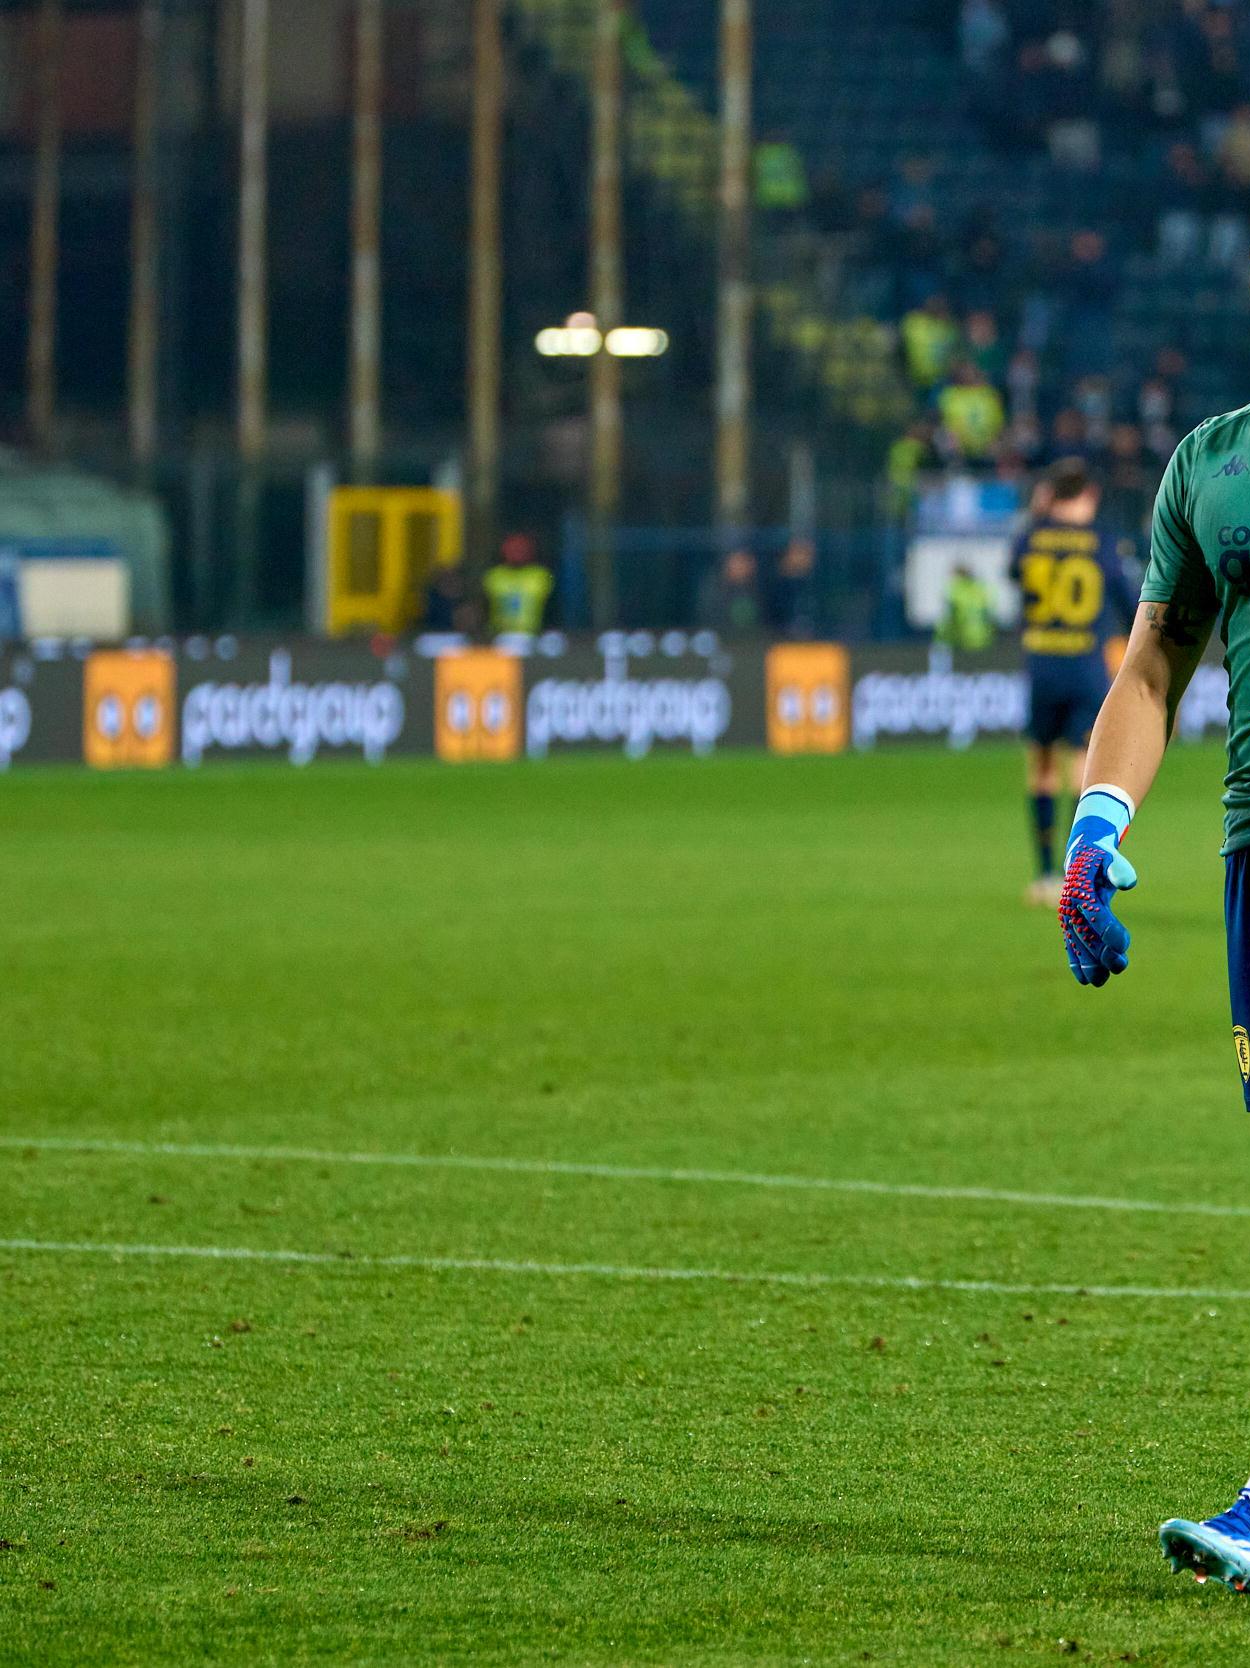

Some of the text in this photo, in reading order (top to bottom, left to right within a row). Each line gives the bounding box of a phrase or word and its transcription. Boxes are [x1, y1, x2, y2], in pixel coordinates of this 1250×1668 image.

[1021, 552, 1104, 625] 30
[182, 649, 403, 767] pardgroup
[526, 643, 731, 760] pardgroup
[853, 641, 1032, 751] pardgrou
